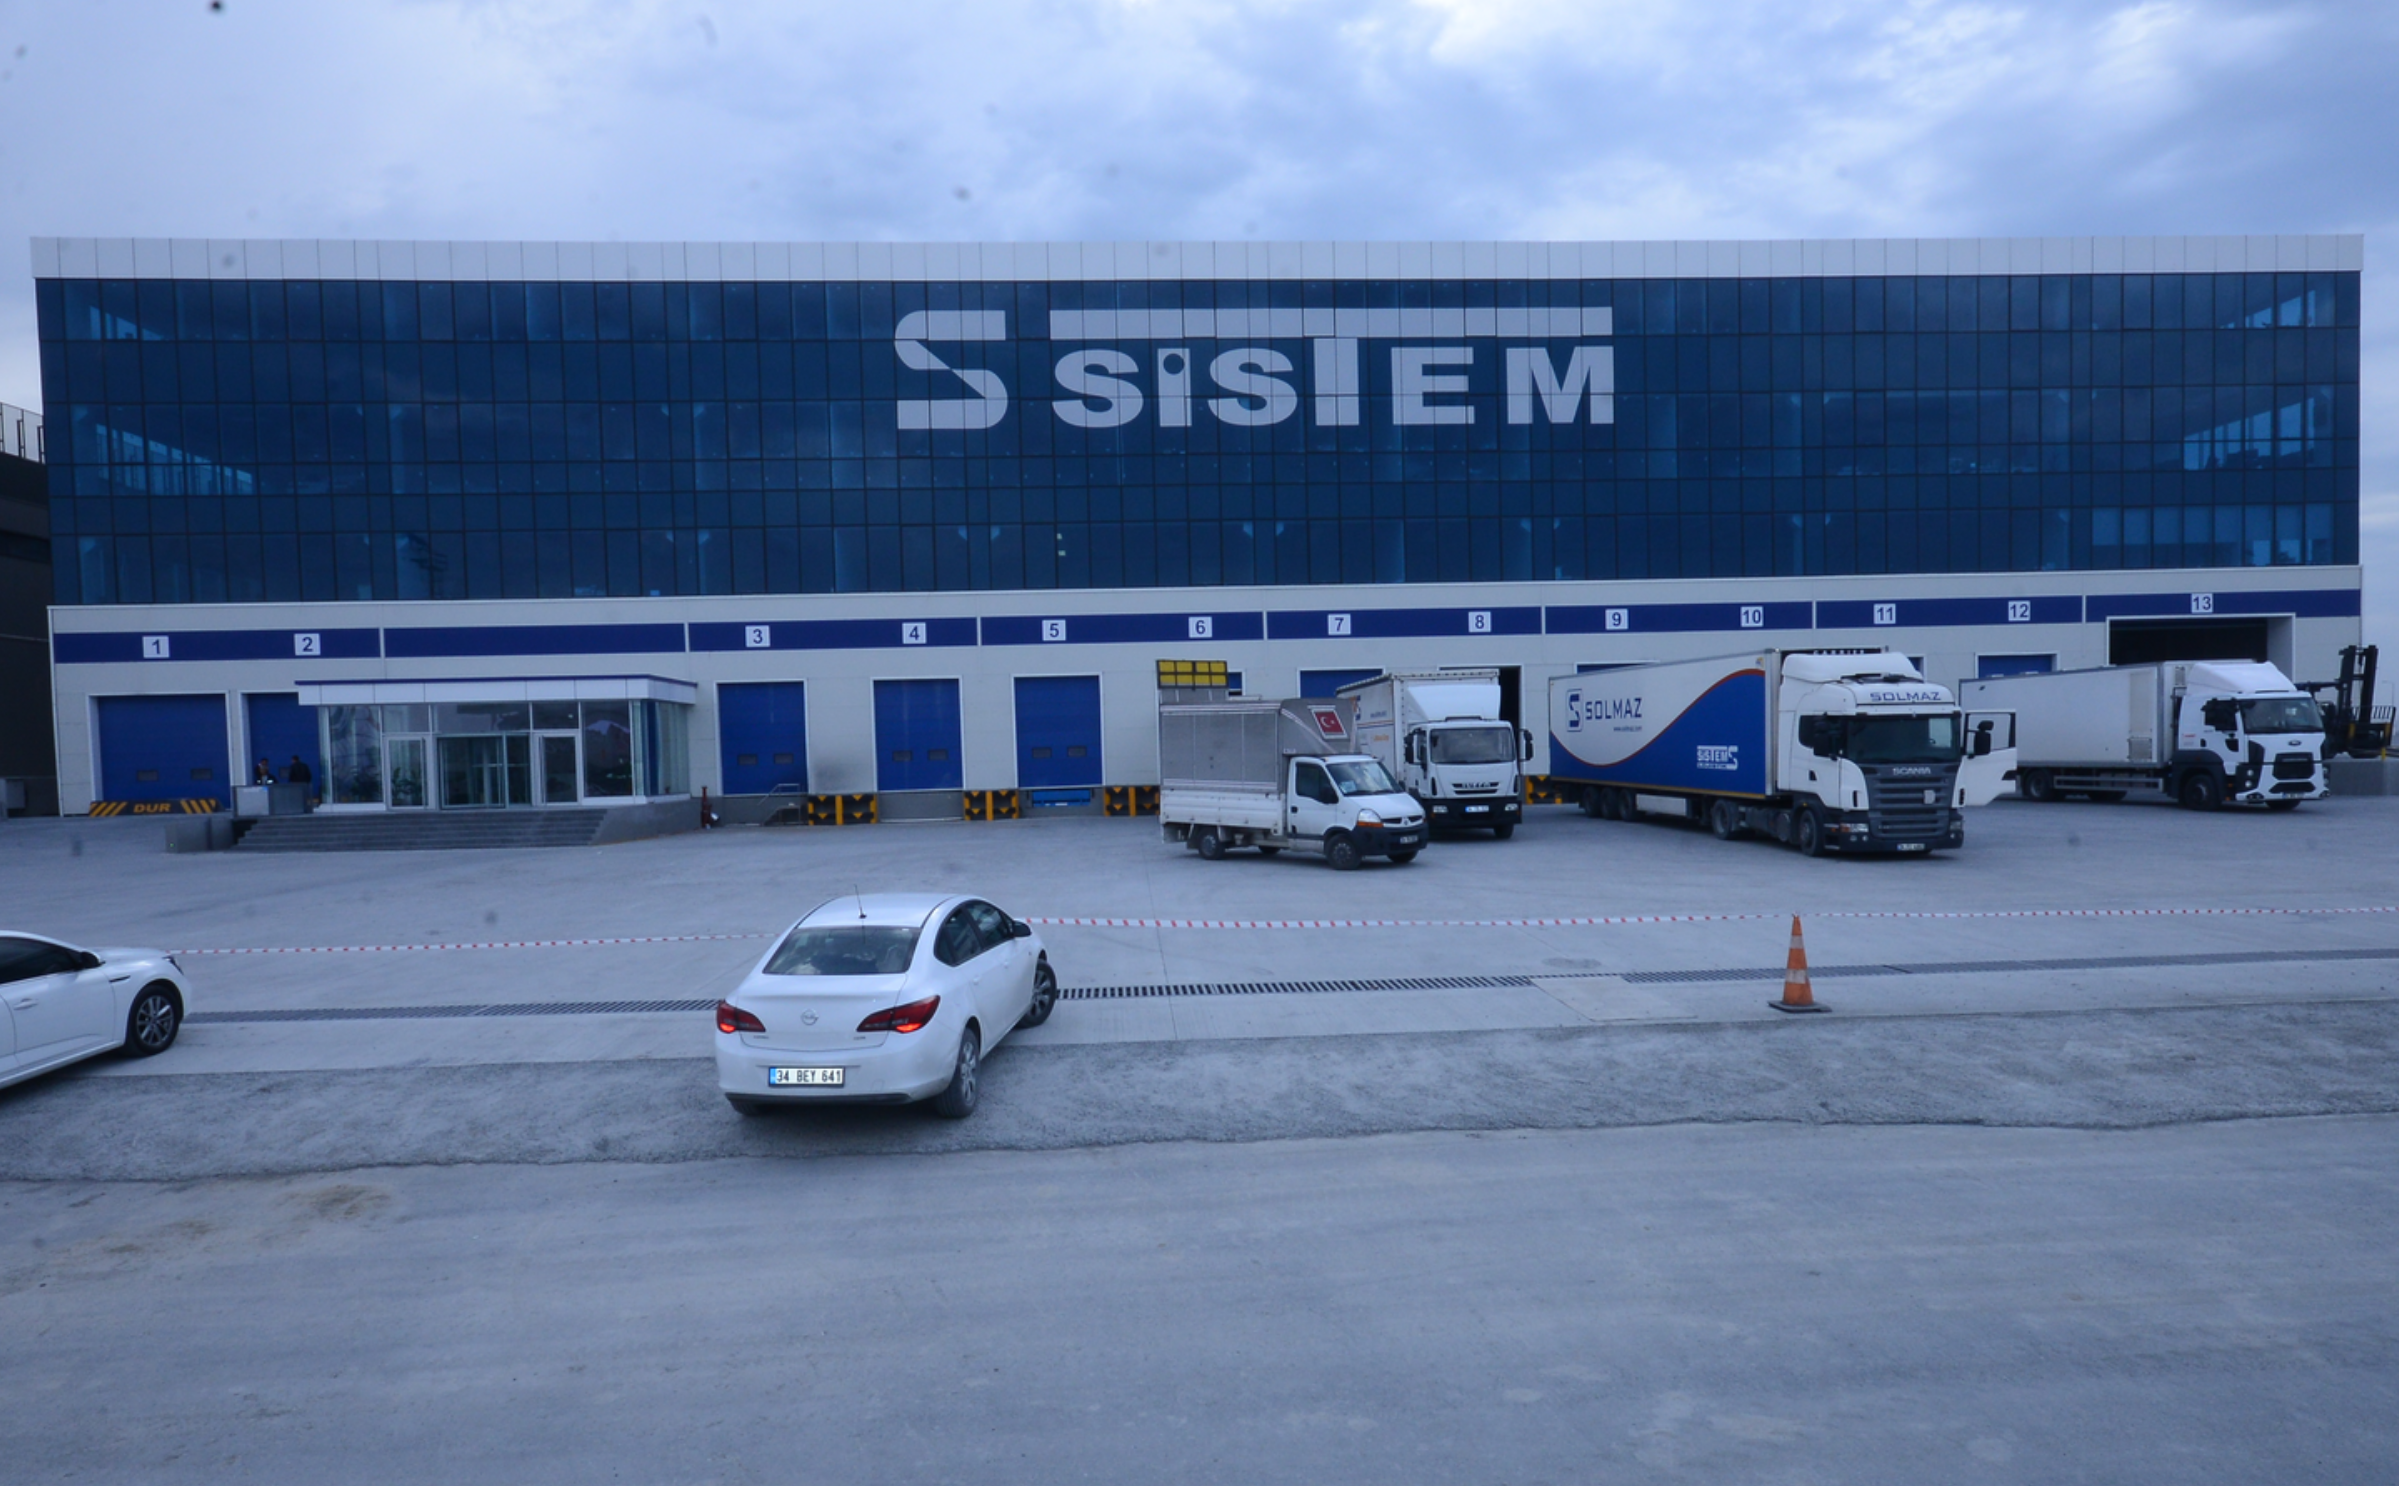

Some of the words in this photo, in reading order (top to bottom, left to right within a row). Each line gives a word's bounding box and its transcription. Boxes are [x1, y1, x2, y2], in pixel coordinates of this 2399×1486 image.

[2009, 603, 2029, 618] 12
[2192, 597, 2212, 610] 13
[1611, 611, 1622, 627] 9
[1742, 609, 1761, 624] 10
[1876, 606, 1893, 621] 11
[1195, 619, 1206, 635] 6
[1334, 617, 1345, 632] 7
[1474, 614, 1485, 630] 8
[753, 628, 763, 645] 3
[909, 625, 920, 641] 4
[1049, 622, 1060, 638] 5
[151, 639, 161, 655] 1
[302, 636, 313, 653] 2
[1869, 691, 1942, 702] SOLMAZ
[1585, 697, 1642, 720] SOLMAZ
[1892, 767, 1931, 775] SCANIA
[133, 803, 171, 813] DUR
[776, 1069, 790, 1083] 34
[796, 1069, 816, 1083] BEY
[821, 1069, 841, 1083] 641
